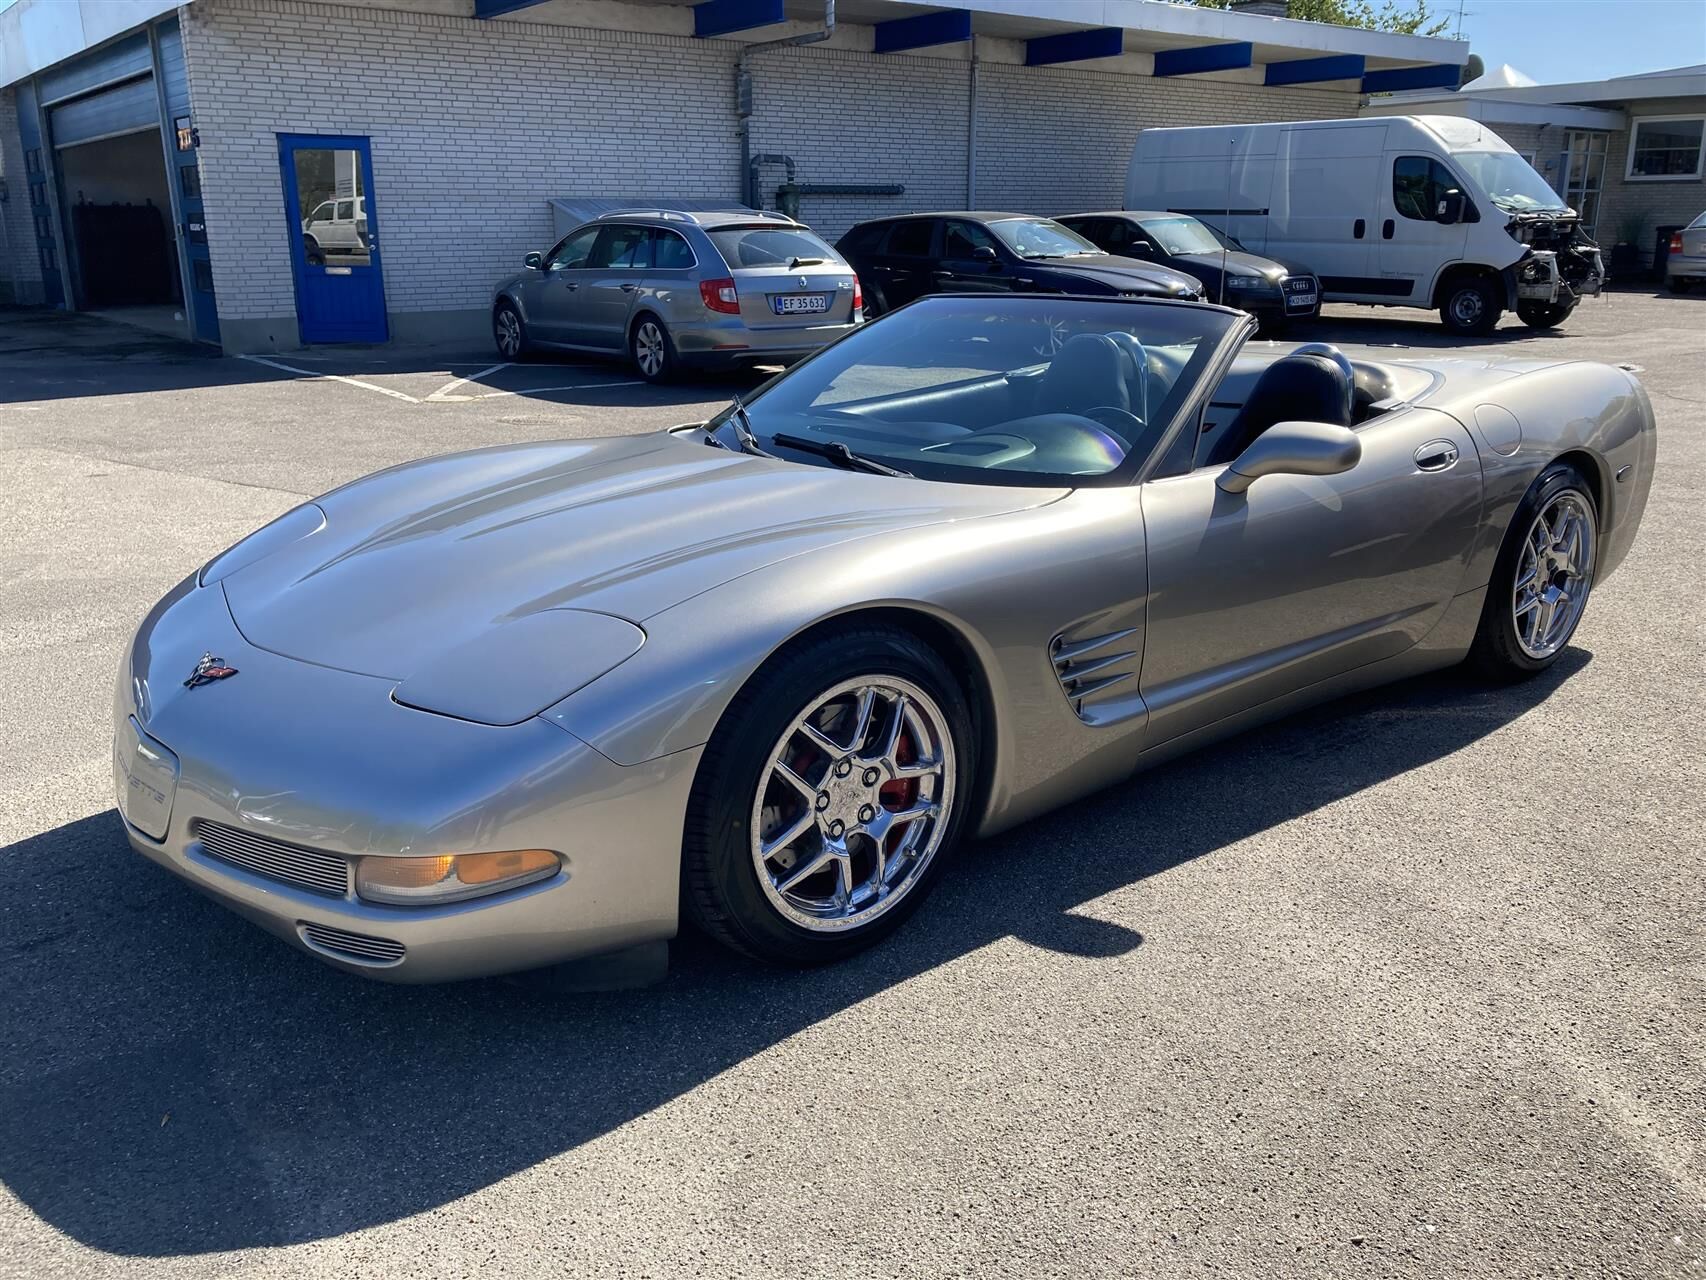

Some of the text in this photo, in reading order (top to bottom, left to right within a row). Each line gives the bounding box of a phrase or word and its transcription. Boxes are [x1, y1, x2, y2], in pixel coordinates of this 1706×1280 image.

[783, 297, 825, 309] EF 35 632
